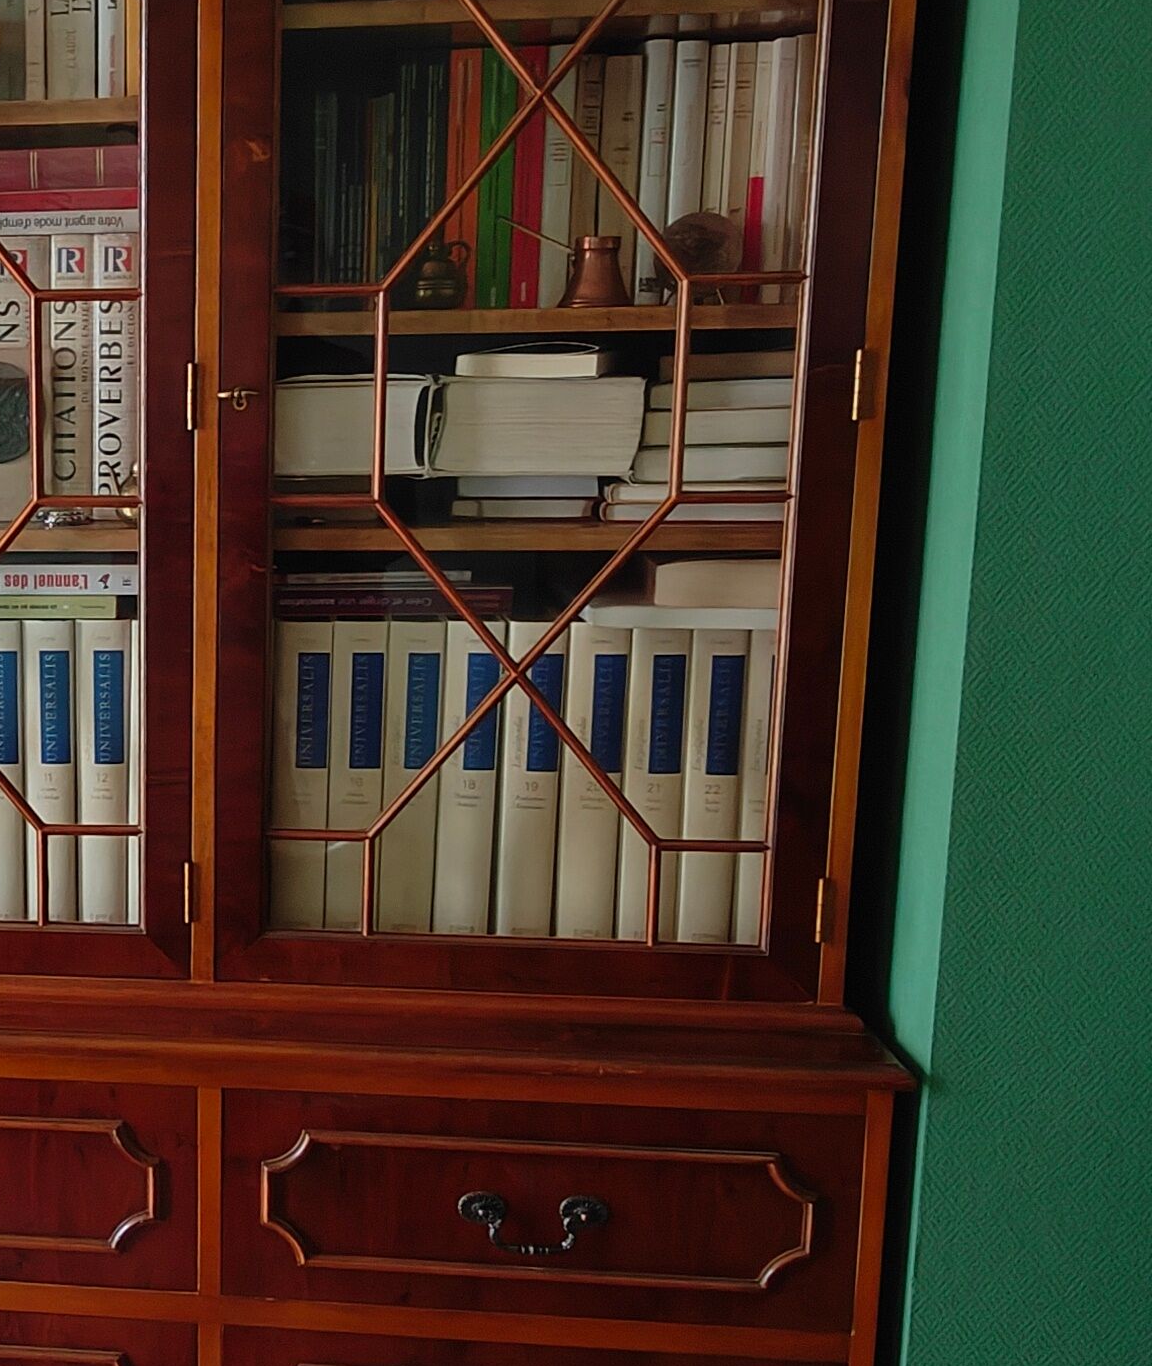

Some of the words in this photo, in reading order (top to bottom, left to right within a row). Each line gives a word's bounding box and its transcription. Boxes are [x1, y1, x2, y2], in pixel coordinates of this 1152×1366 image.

[34, 218, 62, 230] mode
[65, 214, 96, 229] argent
[98, 215, 124, 228] Votre
[52, 300, 78, 481] CITATIONS
[98, 300, 123, 496] PROVERBES
[4, 573, 29, 591] des
[34, 573, 88, 590] L'annuel
[43, 653, 58, 763] UNIVERSALIS
[98, 653, 113, 762] UNIVERSALIS
